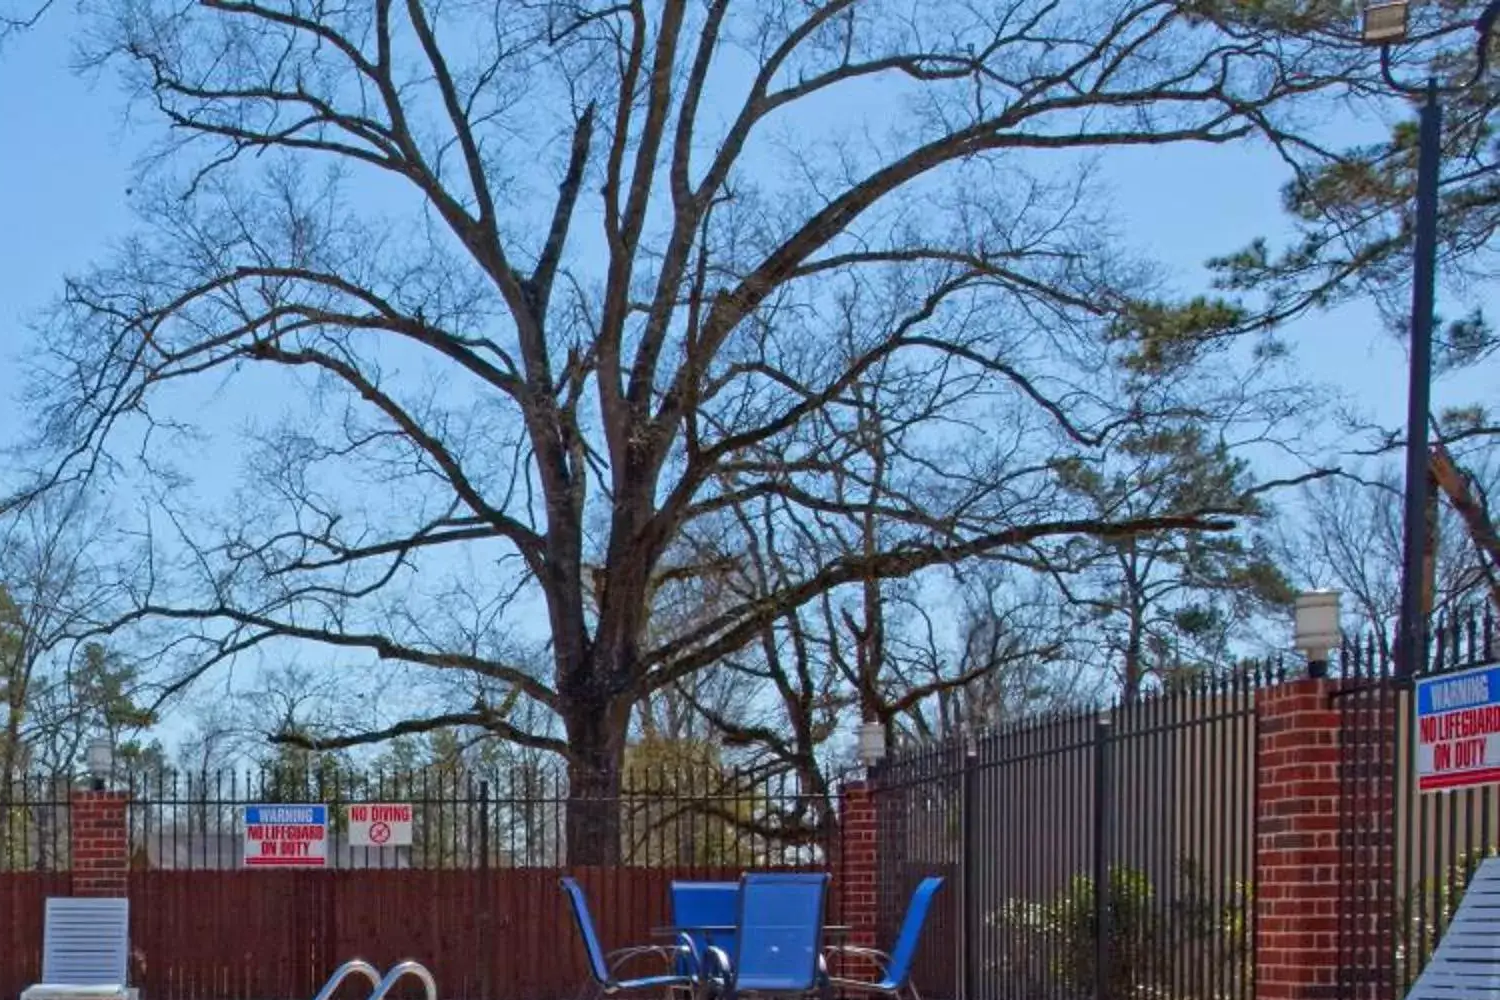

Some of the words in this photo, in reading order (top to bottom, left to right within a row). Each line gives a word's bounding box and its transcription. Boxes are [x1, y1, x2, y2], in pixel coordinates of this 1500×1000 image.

[1430, 674, 1489, 711] WARNING
[1419, 716, 1436, 744] NO
[1439, 705, 1500, 740] LIFEGUARD
[1434, 743, 1451, 771] ON
[1456, 737, 1487, 768] DUTY
[258, 807, 313, 823] WARNING
[352, 806, 367, 822] NO
[371, 806, 410, 822] DIVING
[247, 826, 263, 840] NO
[265, 826, 325, 840] LIFEGUARD
[261, 842, 276, 855] ON
[280, 842, 310, 856] DUTY
